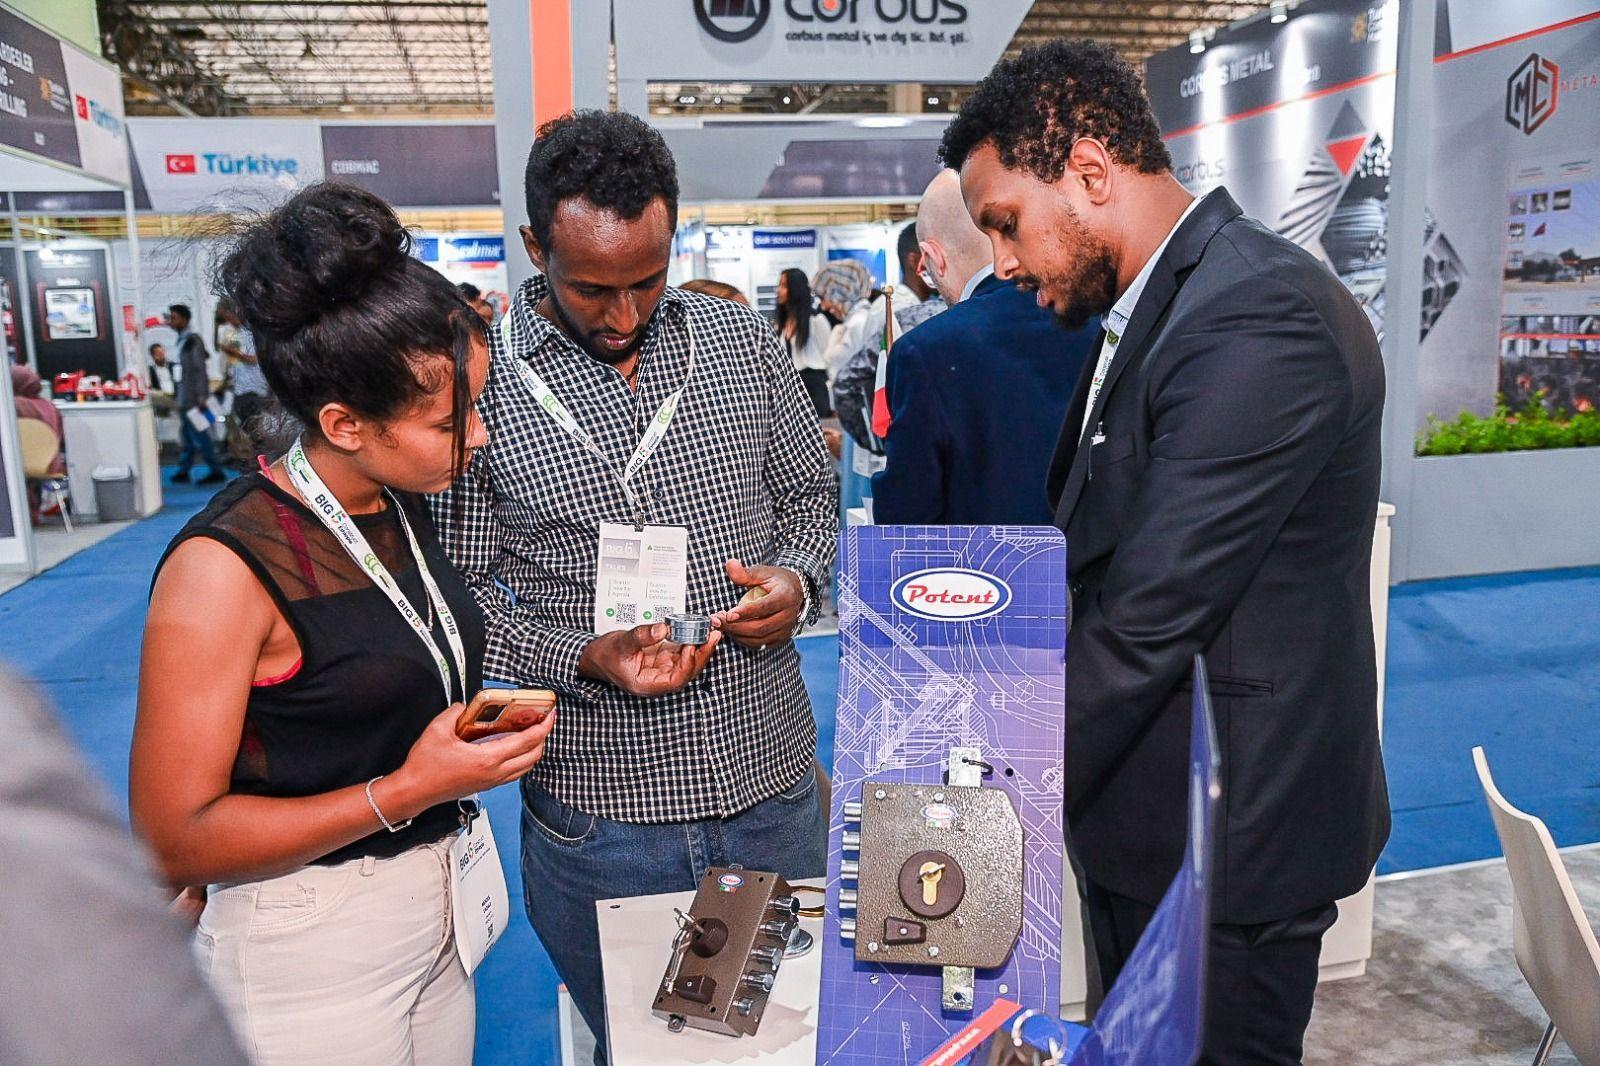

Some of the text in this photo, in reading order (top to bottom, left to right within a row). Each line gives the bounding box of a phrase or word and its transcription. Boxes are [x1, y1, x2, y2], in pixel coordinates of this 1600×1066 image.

[785, 30, 823, 42] corbus
[826, 30, 859, 42] metal
[874, 32, 887, 42] ve
[1230, 50, 1275, 82] METAL
[203, 153, 298, 179] Türkiye
[629, 457, 643, 473] BIG
[314, 493, 334, 516] BIG
[906, 584, 996, 604] Potent
[397, 599, 414, 619] BIG
[444, 615, 457, 636] BIG
